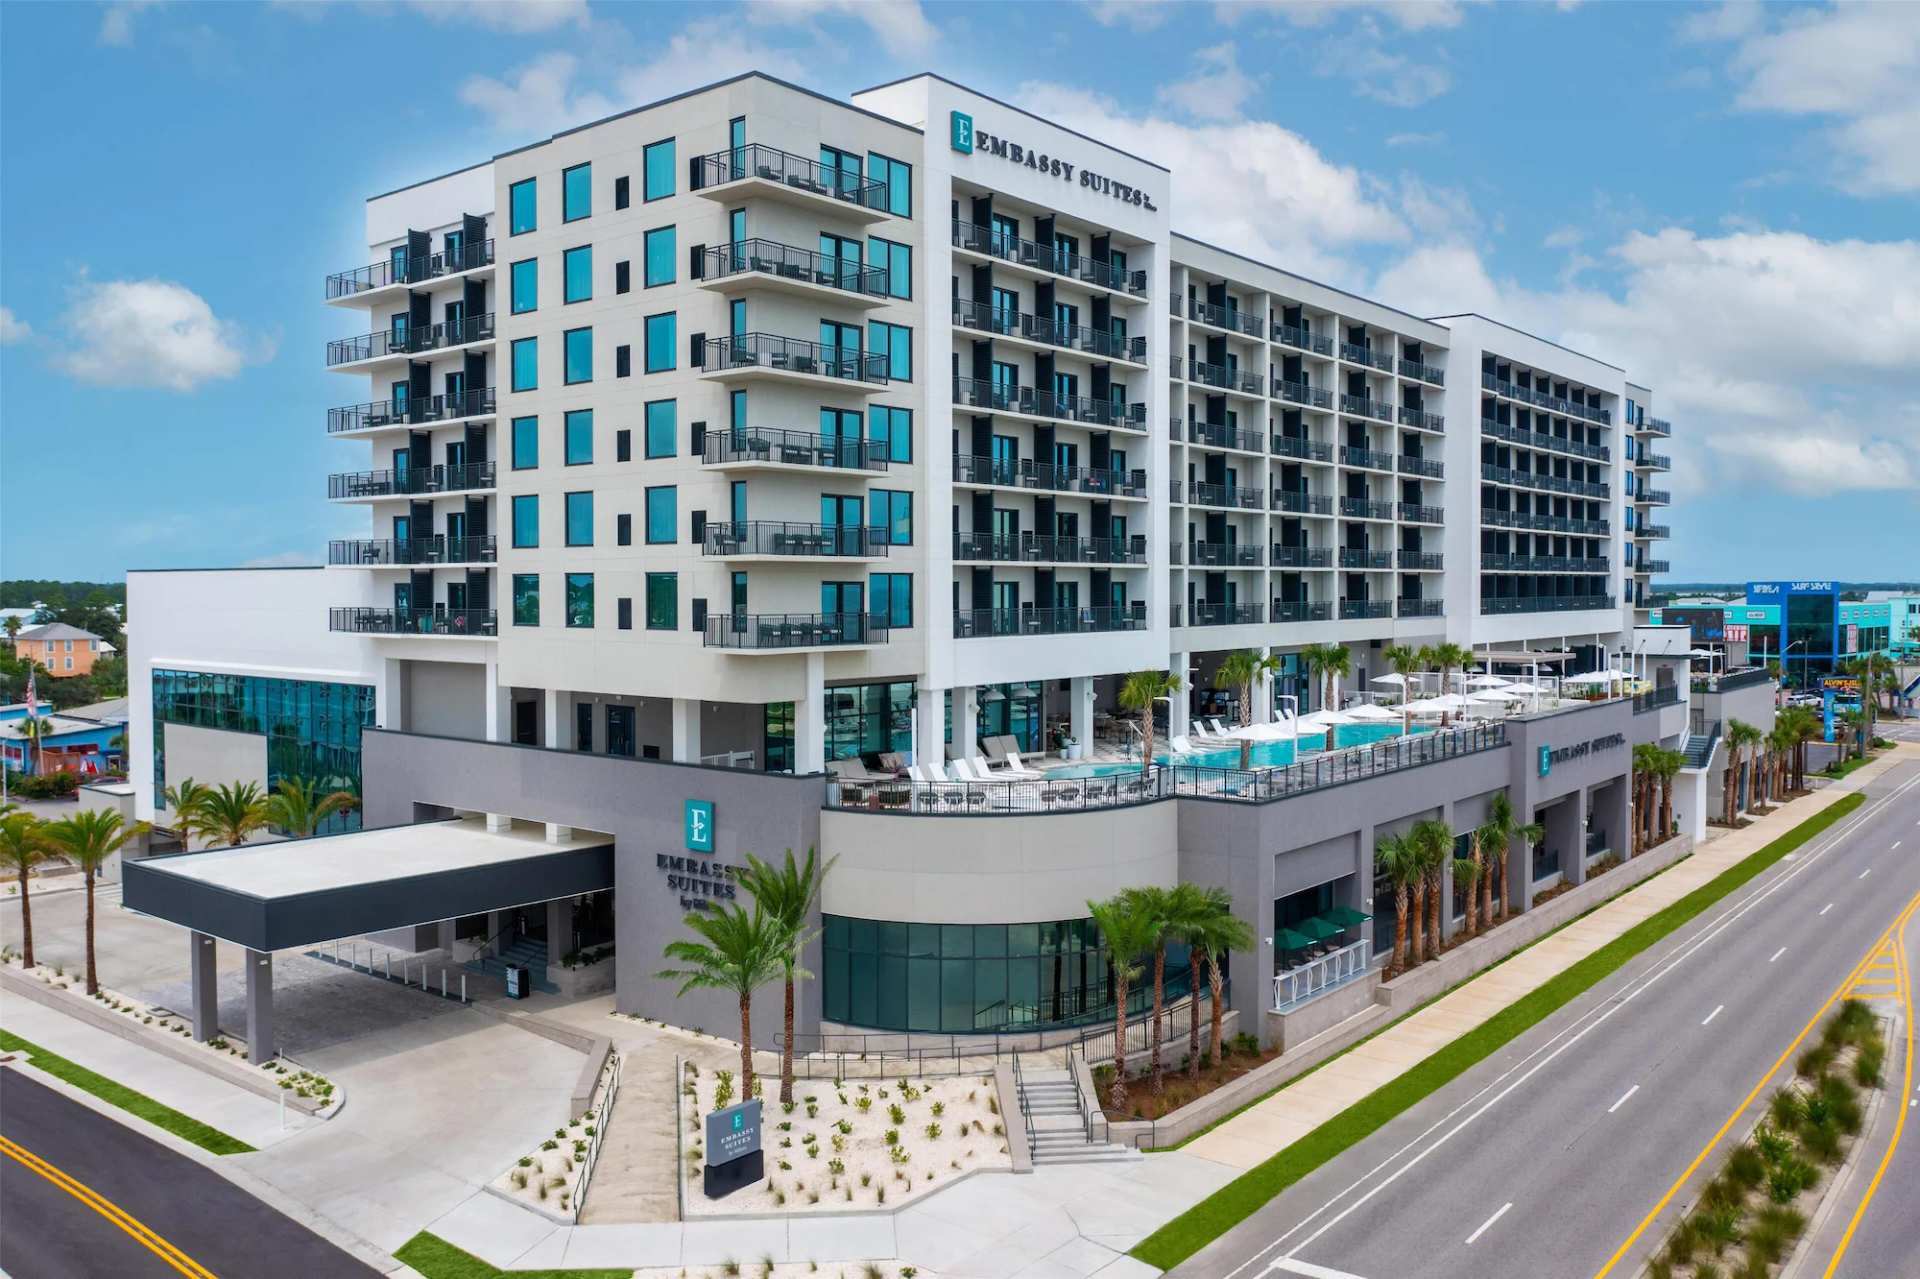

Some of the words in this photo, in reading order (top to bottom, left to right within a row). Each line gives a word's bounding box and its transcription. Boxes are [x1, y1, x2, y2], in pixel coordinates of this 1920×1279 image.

[975, 130, 1075, 181] EMBASSY
[1079, 169, 1142, 206] SUITES
[667, 874, 736, 900] SUITES
[720, 1128, 754, 1144] EMBASSY
[724, 1137, 751, 1149] SUITES
